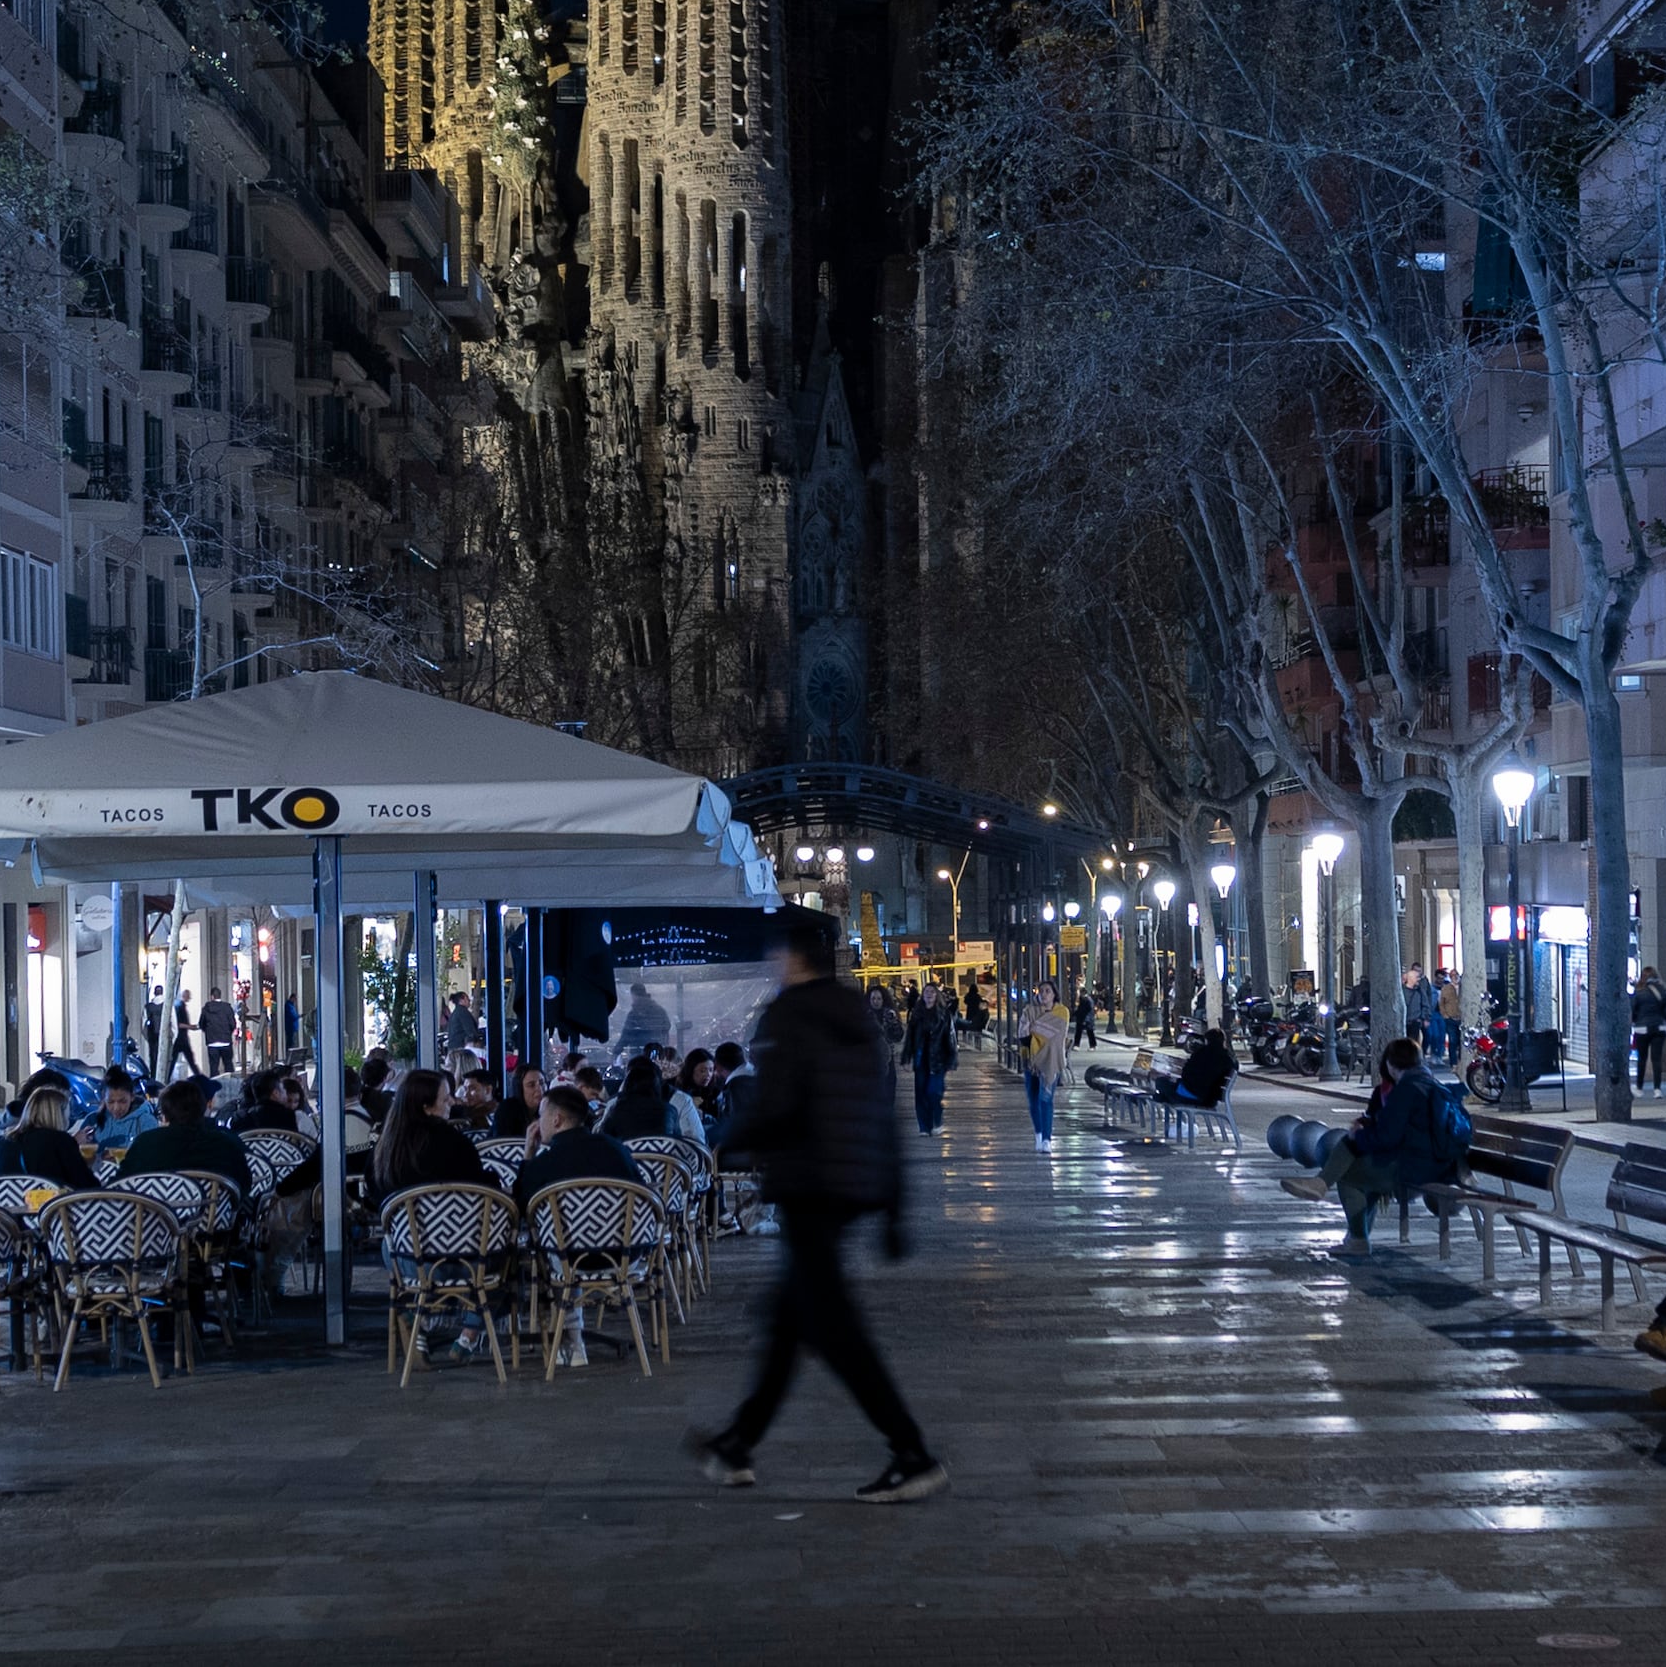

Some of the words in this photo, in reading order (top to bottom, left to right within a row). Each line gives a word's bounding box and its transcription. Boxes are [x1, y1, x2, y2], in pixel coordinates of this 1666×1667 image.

[617, 101, 660, 113] Sanctus
[695, 162, 740, 175] Sanctus
[101, 808, 164, 823] TACOS
[191, 787, 340, 832] TKO
[368, 804, 432, 819] TACOS
